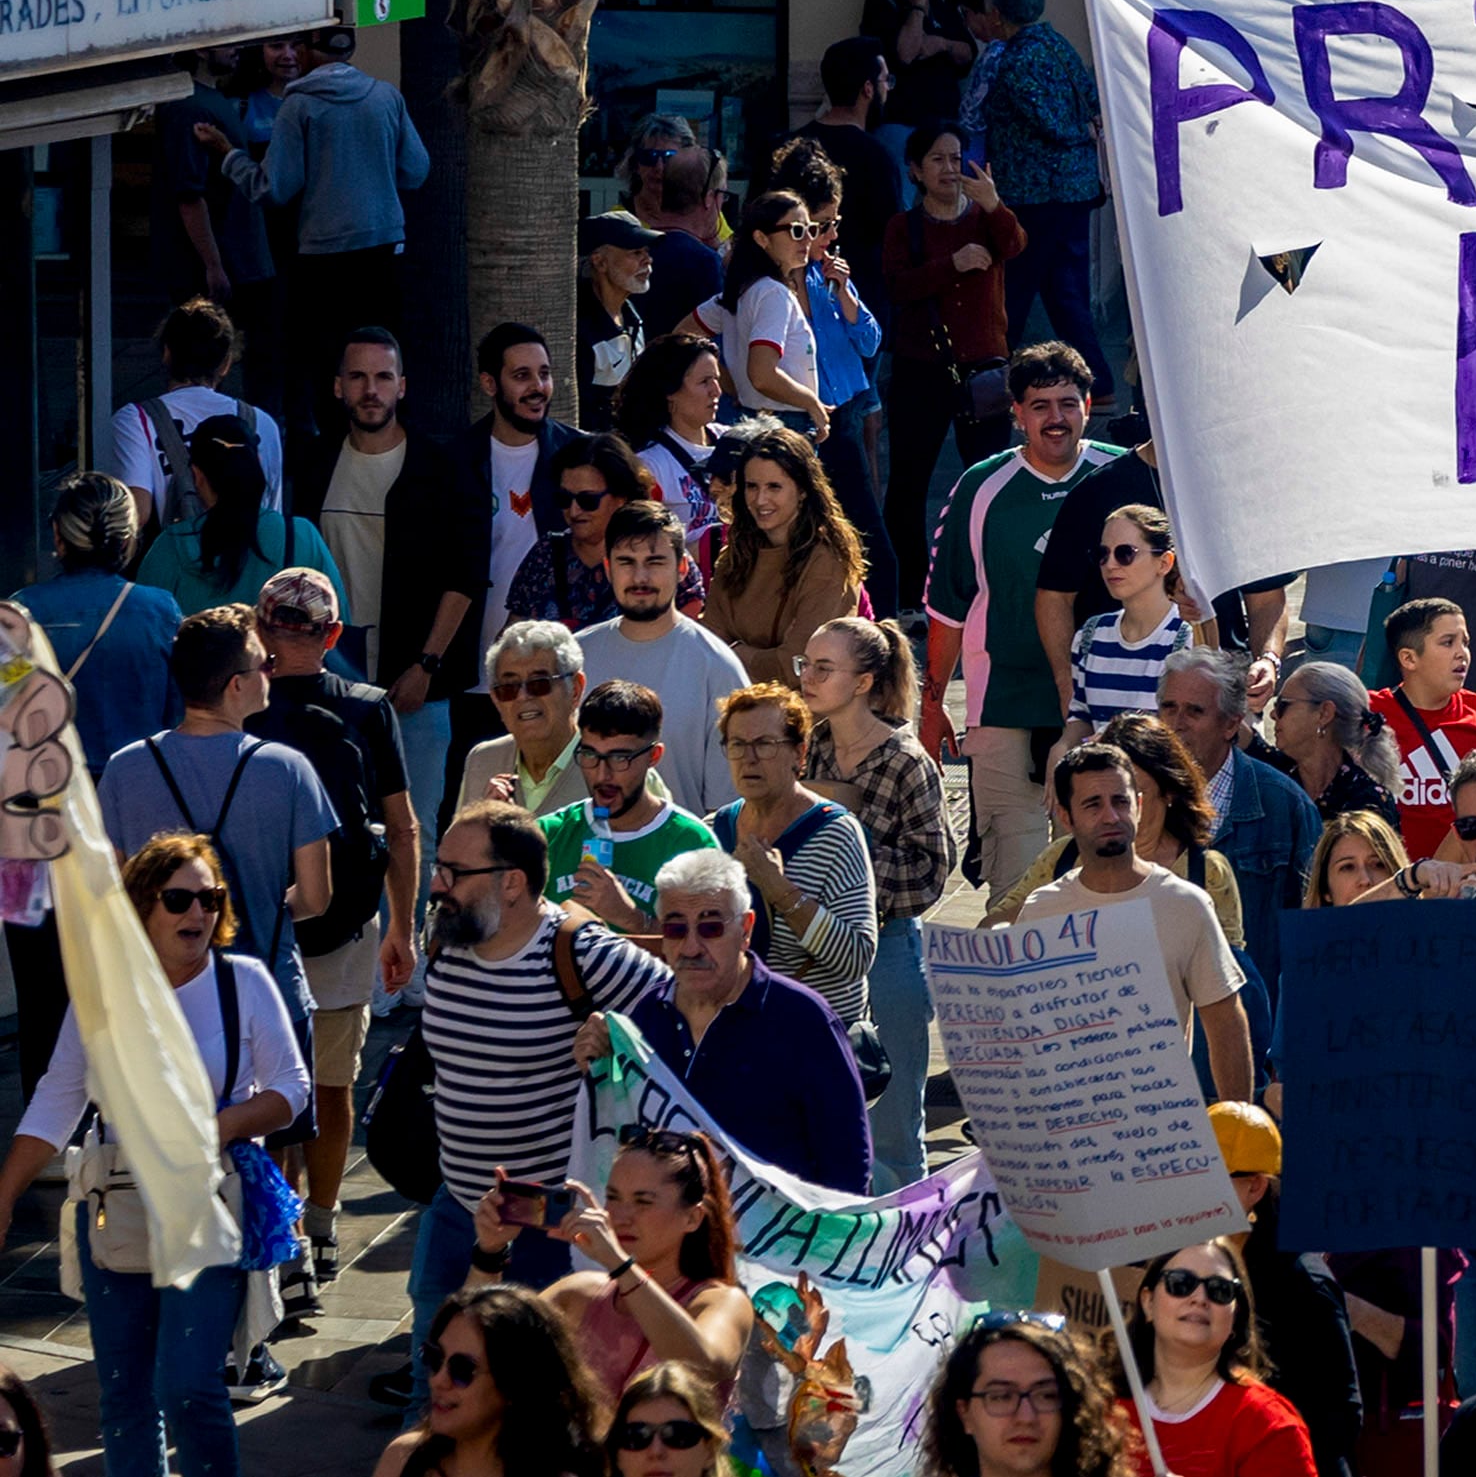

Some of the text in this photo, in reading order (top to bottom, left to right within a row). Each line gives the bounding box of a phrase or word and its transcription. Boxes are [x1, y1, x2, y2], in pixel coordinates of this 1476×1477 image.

[1400, 777, 1452, 806] did
[928, 909, 1099, 967] ARTICULO 47
[987, 978, 1067, 1000] españoles
[937, 985, 1139, 1023] DERECHO a disfrutar de
[967, 1025, 1044, 1041] VIVIENDA
[1054, 1006, 1122, 1030] DIGNA
[1055, 1046, 1142, 1073] condiciones
[1168, 1119, 1193, 1133] de
[1131, 1154, 1220, 1179] ESPECU-
